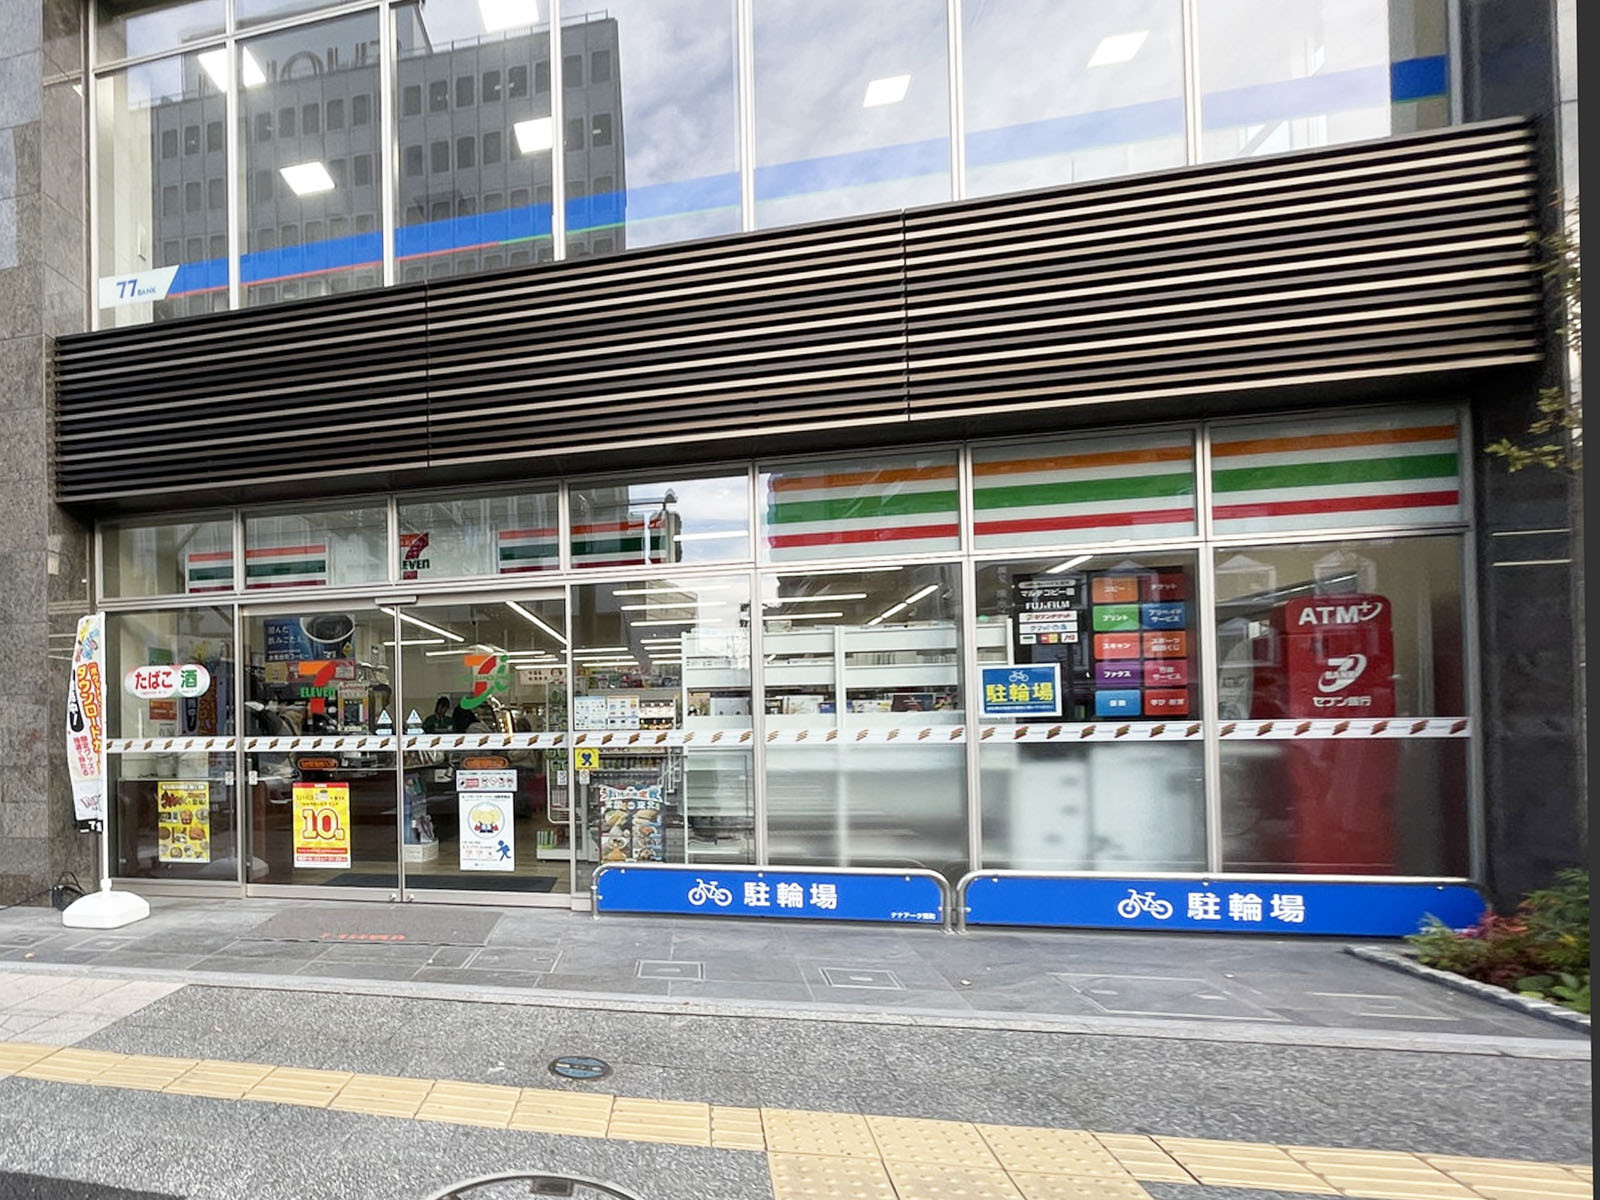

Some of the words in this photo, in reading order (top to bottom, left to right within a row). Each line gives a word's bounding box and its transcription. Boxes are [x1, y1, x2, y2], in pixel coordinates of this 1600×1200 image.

[117, 279, 138, 299] 77
[138, 286, 157, 297] BANK
[1102, 614, 1129, 622] プリント
[1103, 642, 1131, 650] スキャン
[135, 670, 173, 690] たばこ
[180, 669, 198, 689] 酒
[1104, 669, 1132, 679] ファクス
[985, 682, 1054, 702] 駐輪場
[1312, 696, 1372, 708] セブン銀行
[743, 881, 839, 910] 駐輪場
[1186, 891, 1306, 923] 駐輪場
